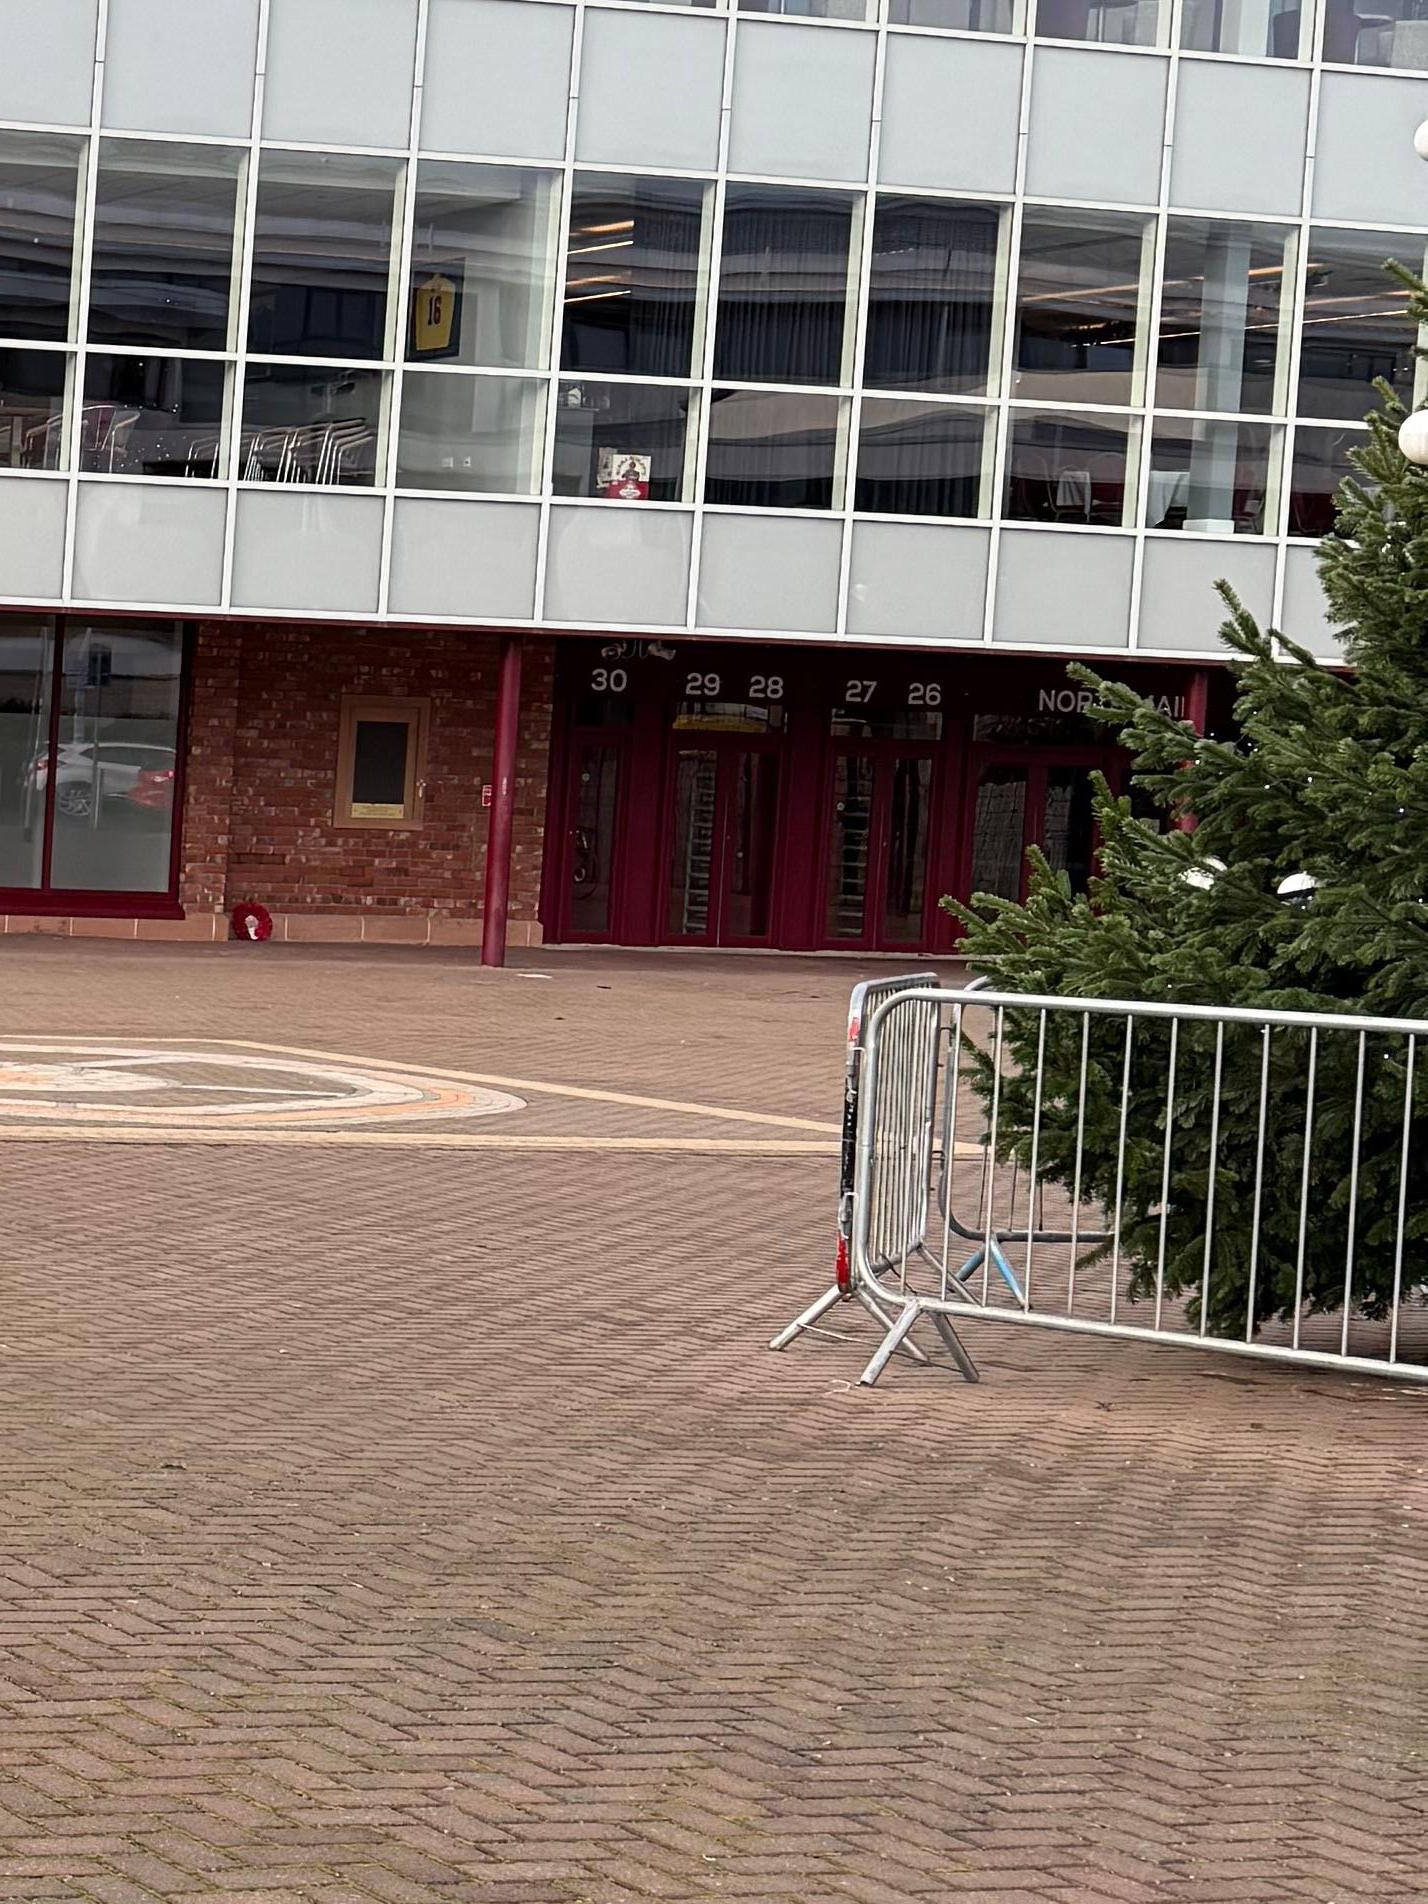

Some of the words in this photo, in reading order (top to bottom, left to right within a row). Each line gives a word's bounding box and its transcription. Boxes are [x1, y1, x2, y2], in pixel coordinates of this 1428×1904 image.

[428, 295, 442, 326] 16
[591, 668, 628, 692] 30
[685, 672, 721, 696] 29
[749, 675, 784, 698] 28
[846, 680, 878, 703] 27
[907, 683, 942, 706] 26
